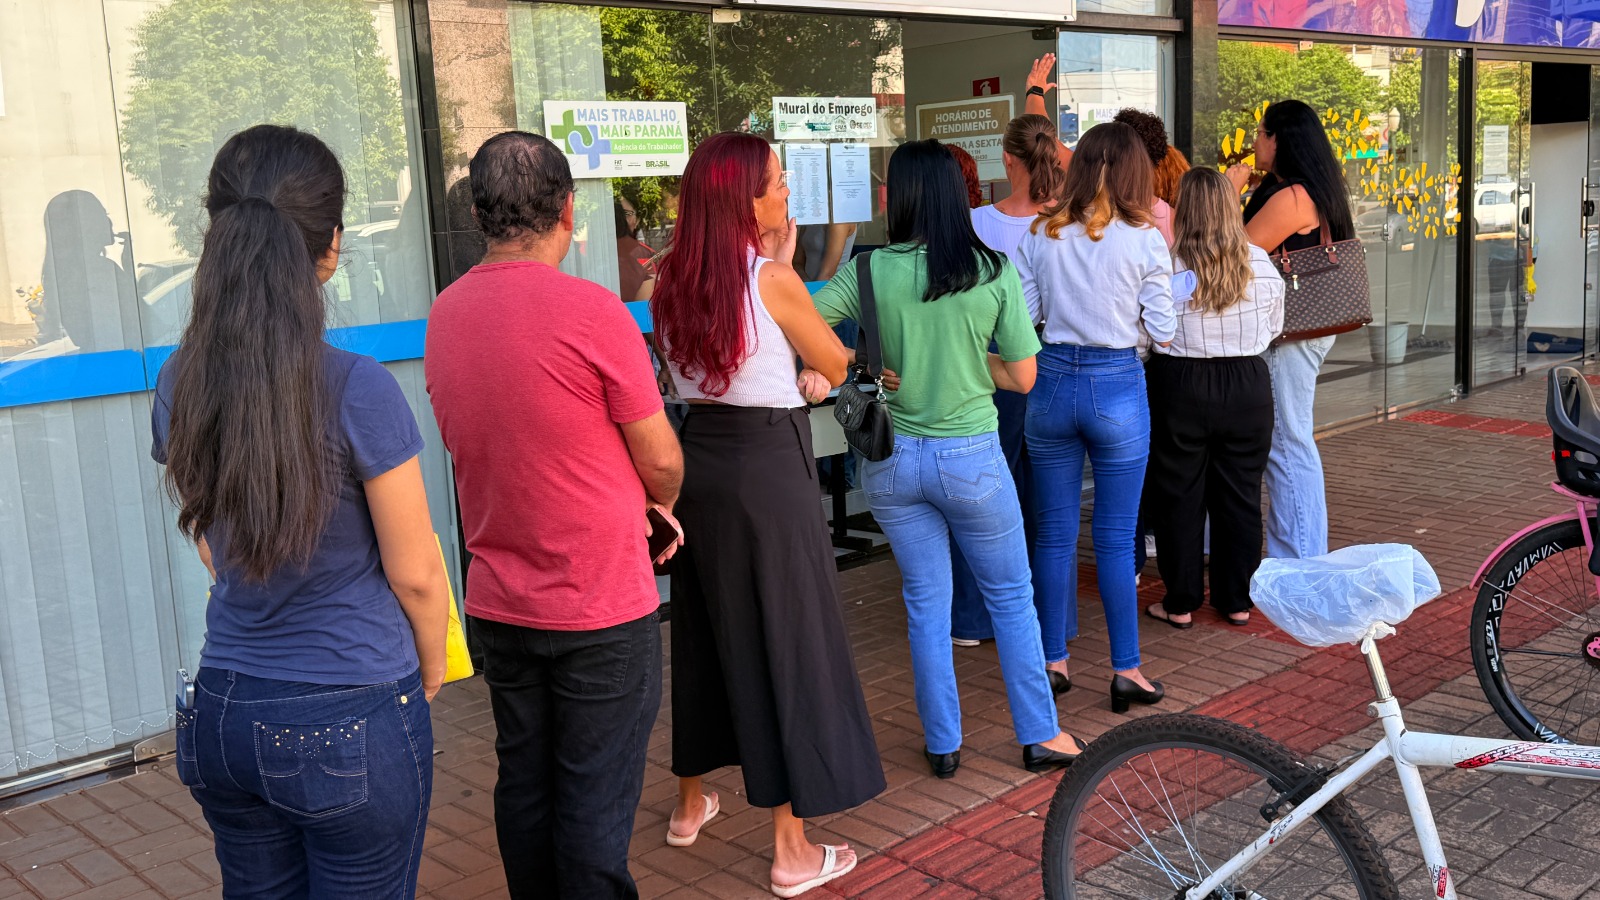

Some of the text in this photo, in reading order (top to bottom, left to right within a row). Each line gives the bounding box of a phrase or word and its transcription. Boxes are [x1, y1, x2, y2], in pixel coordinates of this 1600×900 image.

[577, 109, 676, 121] MAIS TRABALHO
[779, 102, 873, 117] Mural do Emprego
[935, 108, 992, 123] HORÁRIO DE
[1095, 108, 1113, 118] MAIS
[601, 121, 683, 137] MAIS PARANÁ
[930, 119, 999, 135] ATENDIMENTO
[614, 143, 637, 153] Agência
[968, 140, 975, 149] A
[975, 138, 1003, 148] SEXTA
[645, 160, 670, 168] BRASIL
